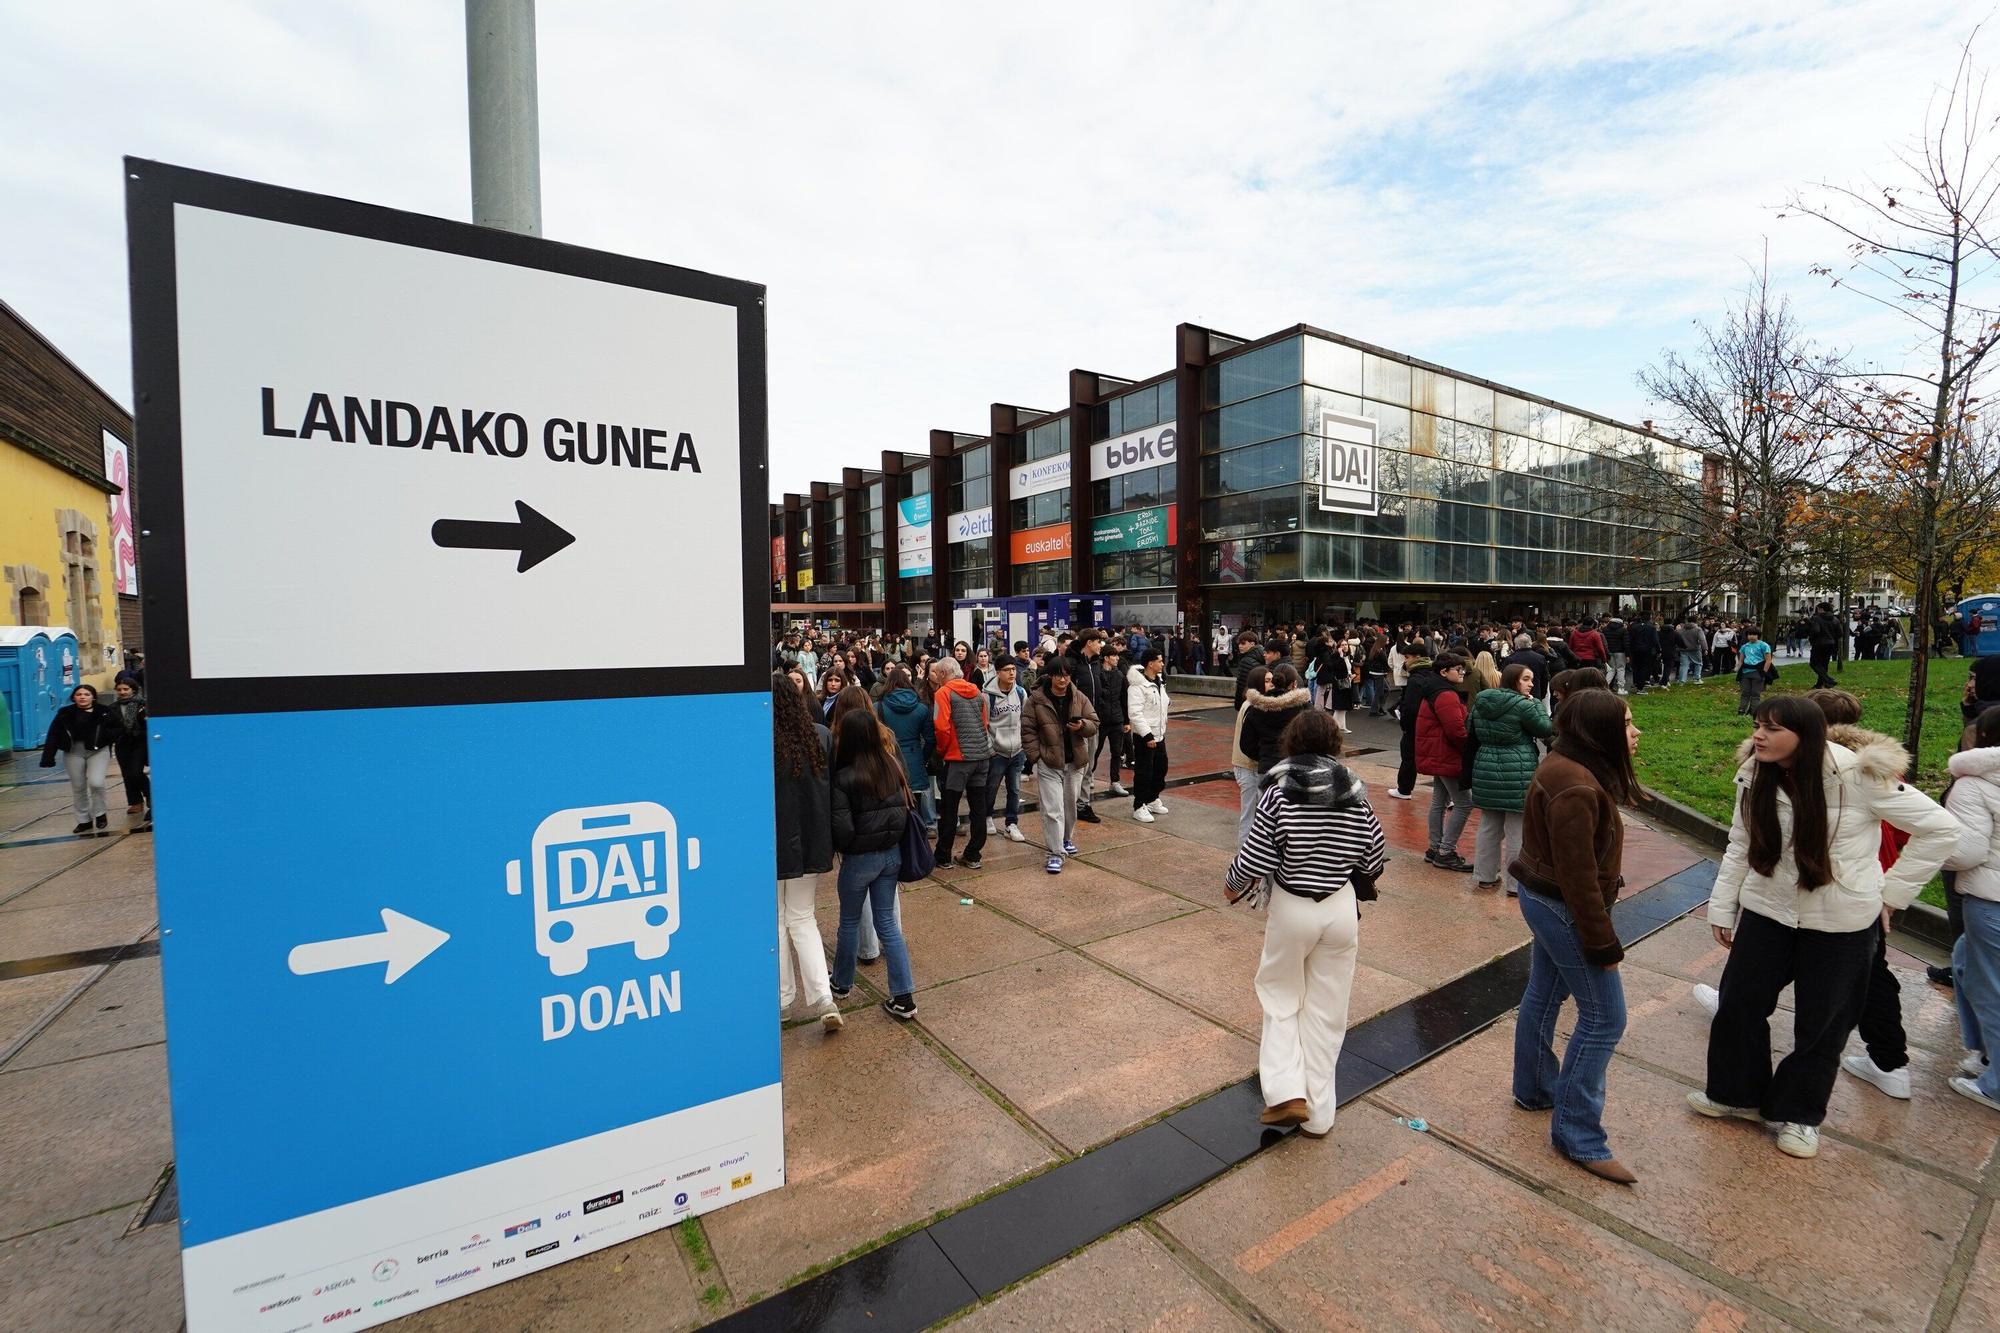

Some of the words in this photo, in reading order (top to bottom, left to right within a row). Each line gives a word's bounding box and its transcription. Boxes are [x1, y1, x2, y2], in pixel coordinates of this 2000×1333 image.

[261, 387, 528, 458] LANDAKO
[543, 418, 702, 473] GUNEA
[1106, 436, 1155, 469] bbk
[1331, 443, 1368, 486] DA!
[1025, 536, 1063, 554] euskaltel
[1137, 534, 1159, 548] EROSKI
[558, 839, 656, 904] DA!
[541, 970, 681, 1042] DOAN
[719, 1155, 745, 1168] elhuyar
[555, 1210, 571, 1221] dot
[416, 1248, 449, 1264] berria
